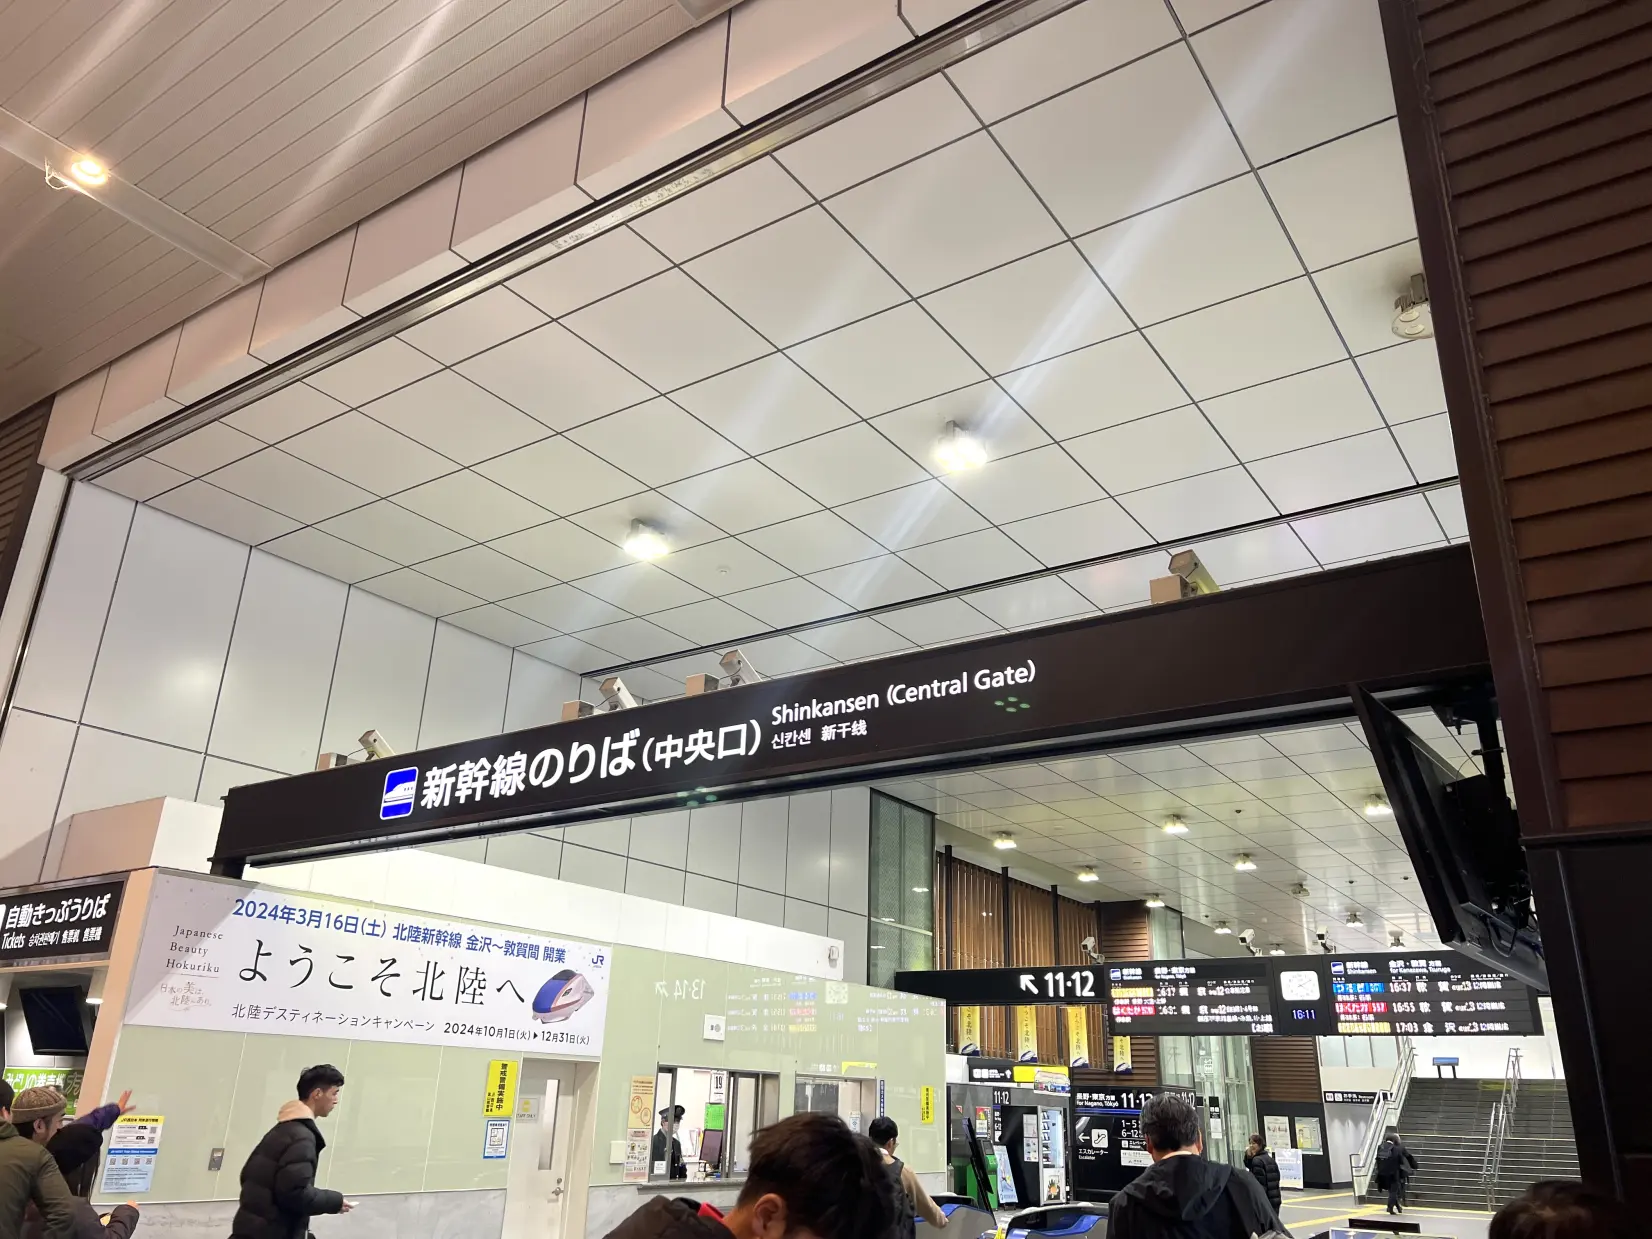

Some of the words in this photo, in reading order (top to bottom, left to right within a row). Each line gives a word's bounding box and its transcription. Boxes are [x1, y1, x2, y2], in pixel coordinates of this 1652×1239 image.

[771, 692, 880, 725] Shinkansen
[887, 673, 971, 706] (Central
[974, 659, 1037, 690] Gate)
[821, 719, 868, 742] 新干线
[771, 730, 812, 751] 신칸센
[421, 720, 762, 809] 新幹線のりば(中央口)
[5, 893, 112, 930] 自動きっぷうりば
[173, 925, 224, 940] Japanese
[233, 898, 386, 938] 2024年3月16日(土)
[392, 922, 463, 949] 北陸新幹線
[543, 945, 567, 963] 開業
[2, 931, 25, 949] Tickets
[170, 941, 209, 957] Beauty
[166, 958, 220, 973] Hokuriku
[592, 955, 604, 965] JR
[238, 938, 526, 1006] ようこそ北陸へ
[1389, 981, 1412, 993] 16:37
[1292, 1009, 1316, 1020] 16:11
[1392, 1002, 1415, 1013] 16:55
[232, 1002, 435, 1032] 北陸デスティネーションキャンペーン
[443, 1020, 531, 1041] 2024年10月1日(火)
[540, 1029, 590, 1047] 12月31日(火)
[1395, 1022, 1419, 1033] 17:03
[715, 1076, 723, 1089] 19
